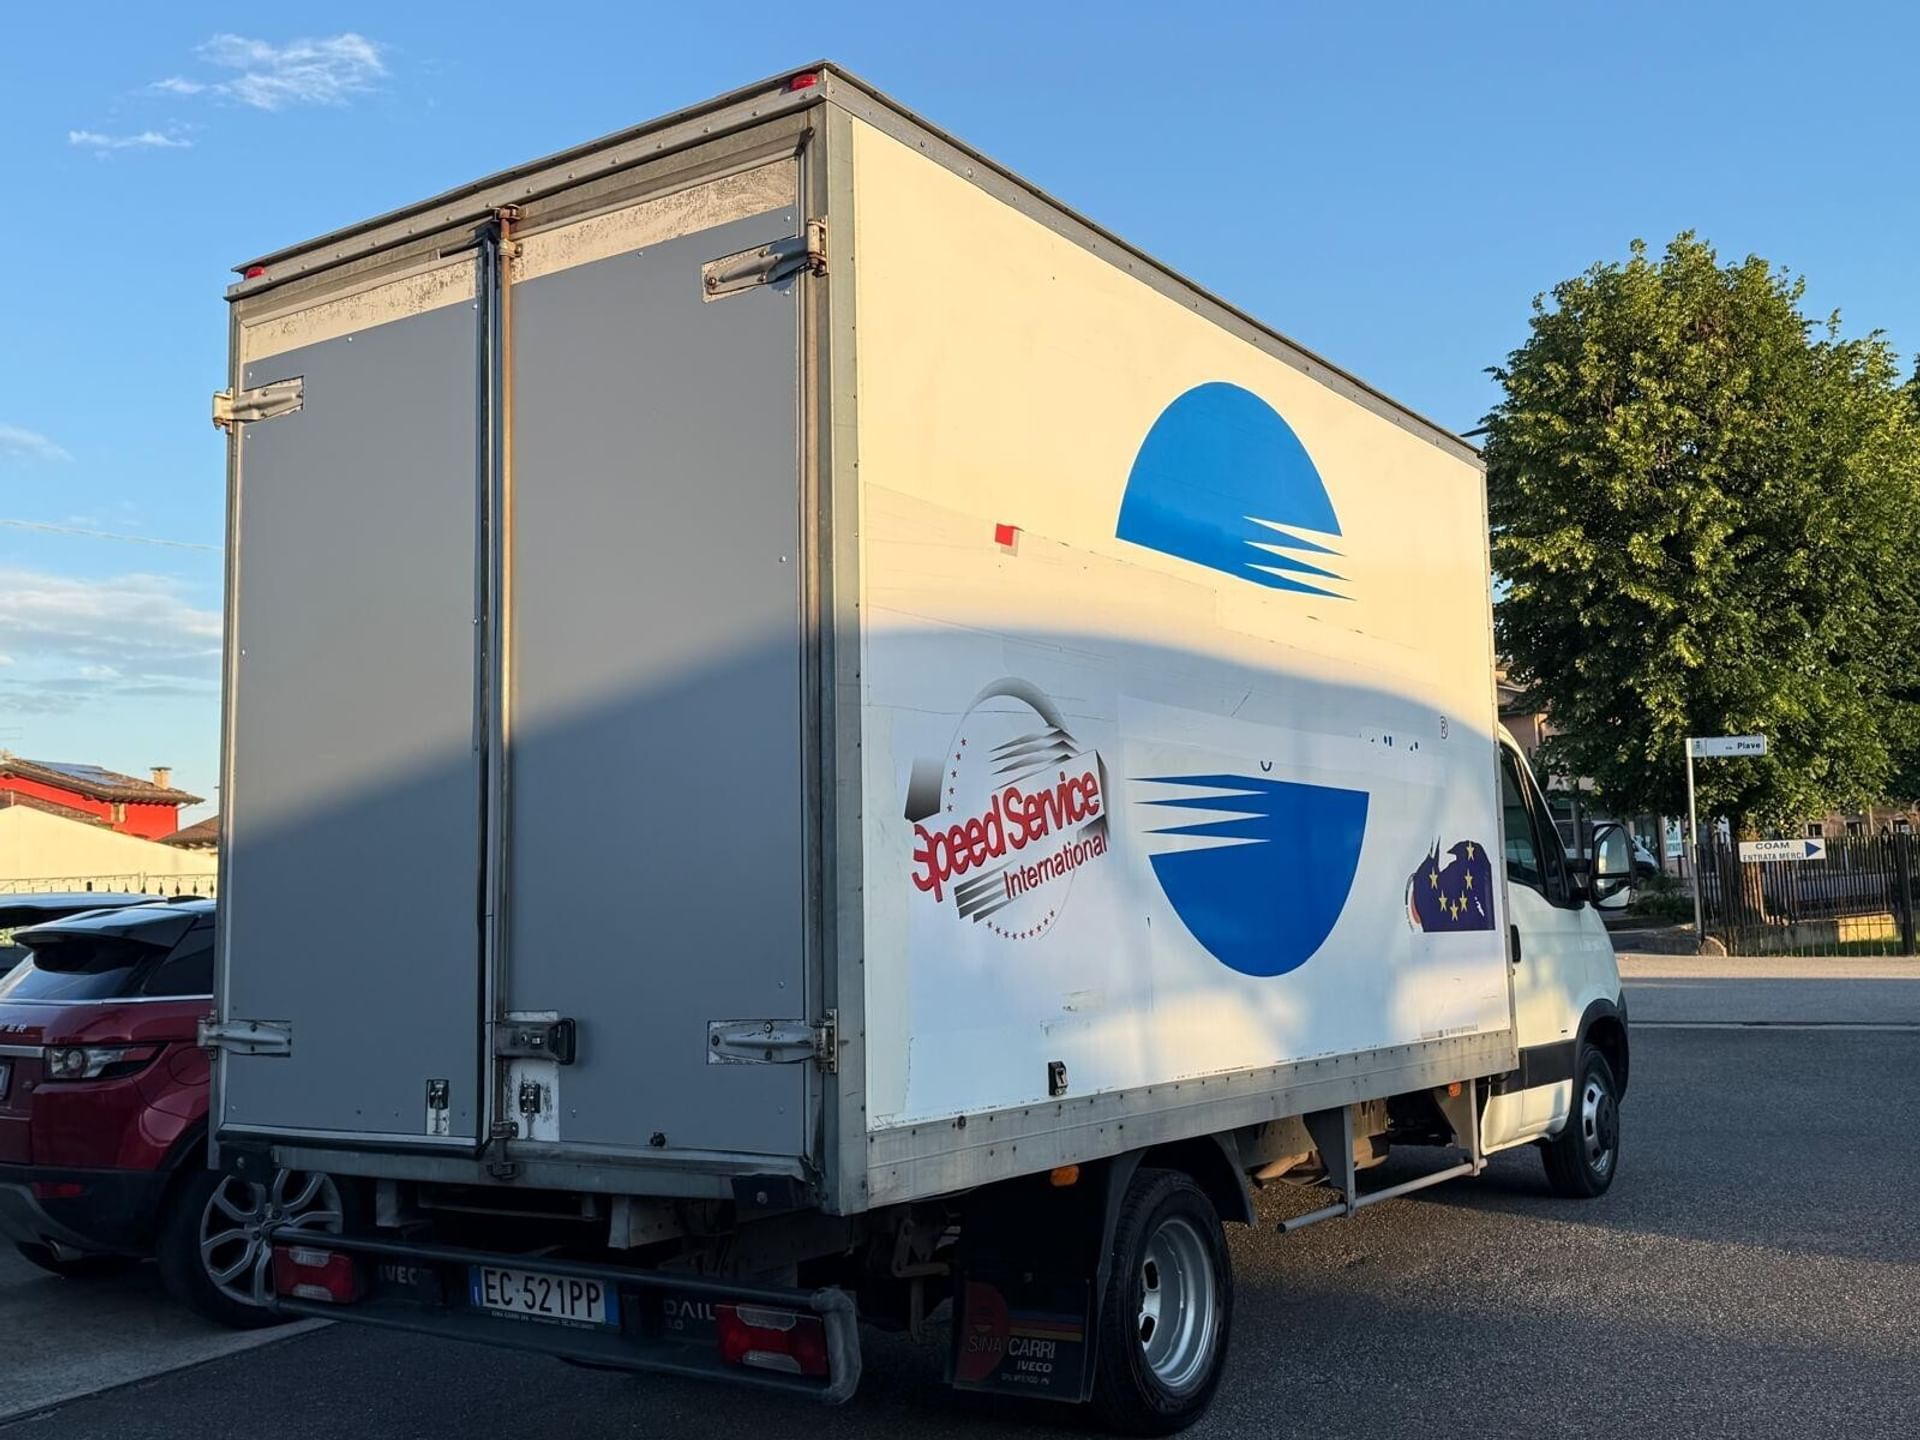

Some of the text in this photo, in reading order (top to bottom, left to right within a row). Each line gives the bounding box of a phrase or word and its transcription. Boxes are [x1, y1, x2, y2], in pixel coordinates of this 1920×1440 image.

[1003, 771, 1100, 849] Service
[1004, 832, 1108, 899] International
[378, 1263, 424, 1286] IVEC
[484, 1269, 600, 1318] EC 521PP
[663, 1298, 717, 1321] DAIL
[1008, 1337, 1056, 1359] CARRI
[1017, 1360, 1053, 1373] IVECO
